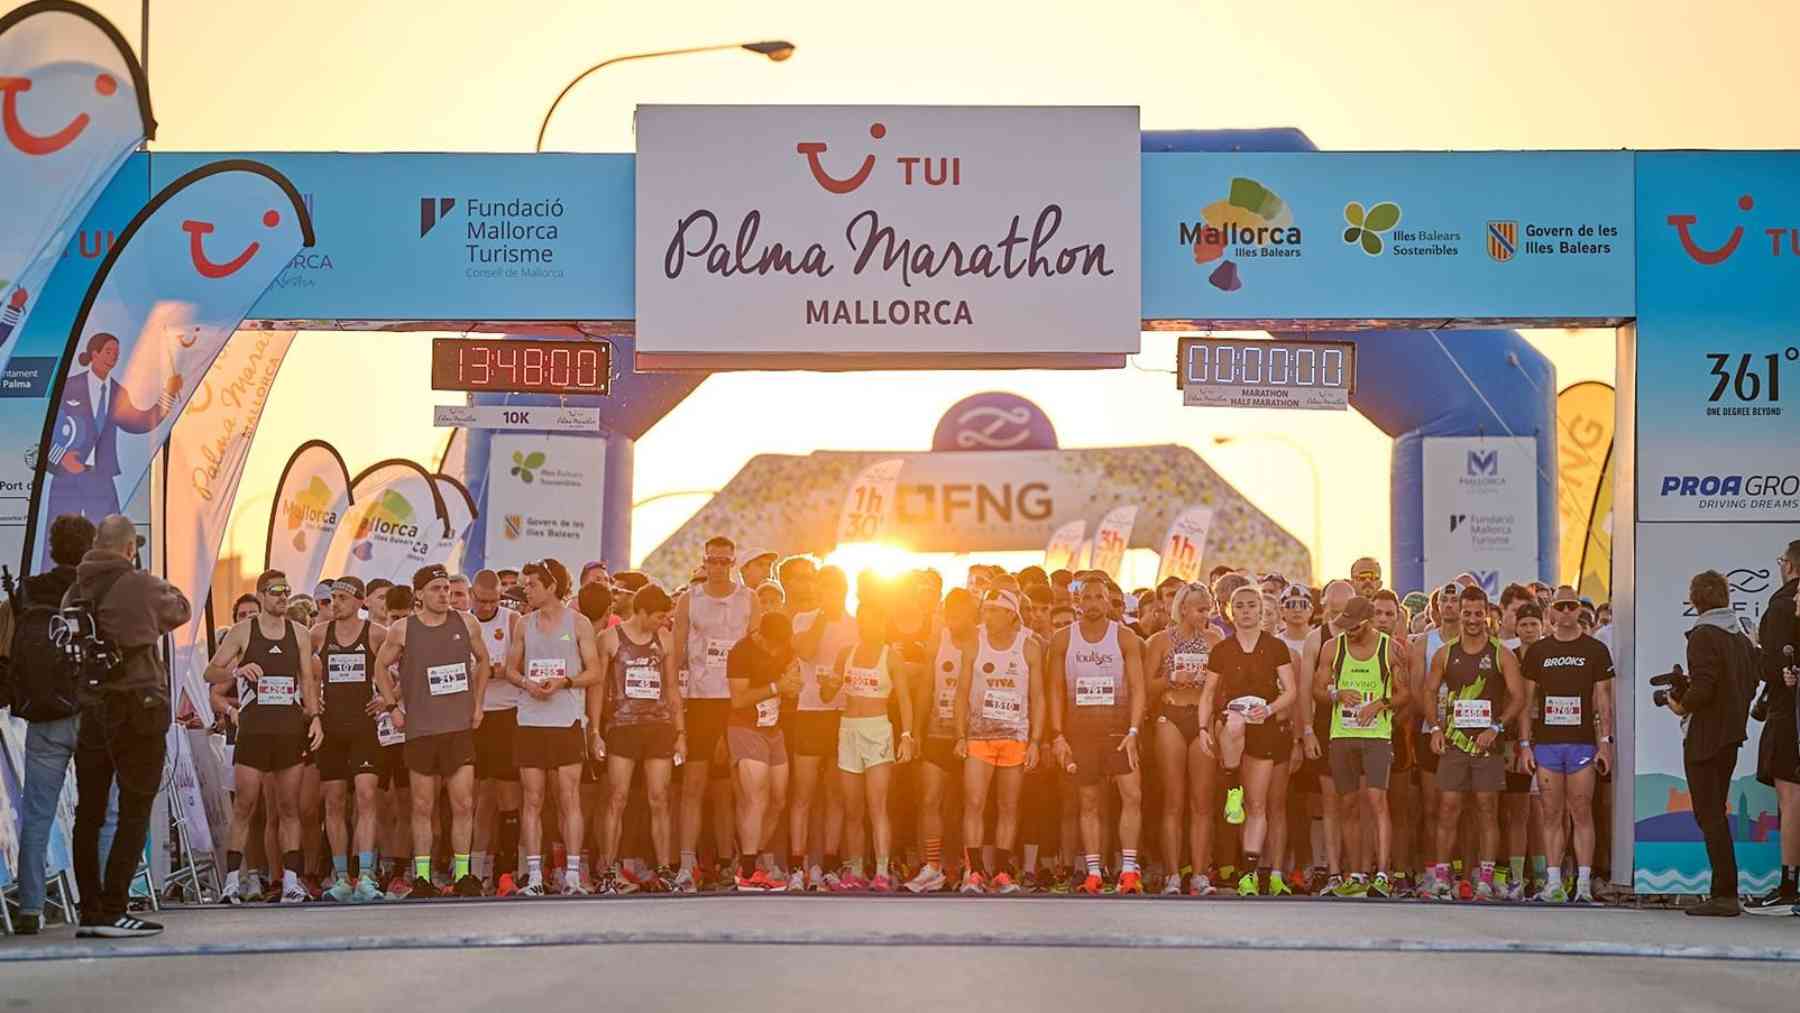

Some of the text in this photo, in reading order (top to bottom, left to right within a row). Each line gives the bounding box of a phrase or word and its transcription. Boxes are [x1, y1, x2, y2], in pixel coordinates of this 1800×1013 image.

[897, 157, 961, 185] TUI
[466, 197, 565, 218] Fundació
[466, 220, 559, 240] Mallorca
[1178, 221, 1302, 246] Mallorca
[1392, 231, 1462, 242] Illes Balears
[1525, 224, 1618, 238] Govern de les
[664, 204, 1114, 287] Palma Marathon
[1235, 247, 1302, 258] Illes Balears
[1392, 244, 1459, 257] Sostenibles
[1525, 242, 1612, 255] Illes Balears
[465, 243, 554, 263] Turisme
[805, 299, 974, 326] MALLORCA
[458, 346, 598, 388] 13:48:00
[1188, 345, 1343, 387] 00:00:00
[2, 380, 32, 390] Palma
[1241, 388, 1289, 398] MARATHON
[1230, 398, 1252, 407] HALF
[1253, 399, 1300, 408] MARATHON
[503, 411, 531, 425] 10K
[1706, 407, 1721, 416] ONE
[1722, 407, 1750, 416] DEGREE
[0, 480, 23, 491] Port
[1660, 475, 1743, 496] PROA
[1698, 499, 1799, 509] DRIVING DREAMS
[359, 514, 419, 539] allorca
[1543, 656, 1586, 668] BROOKS
